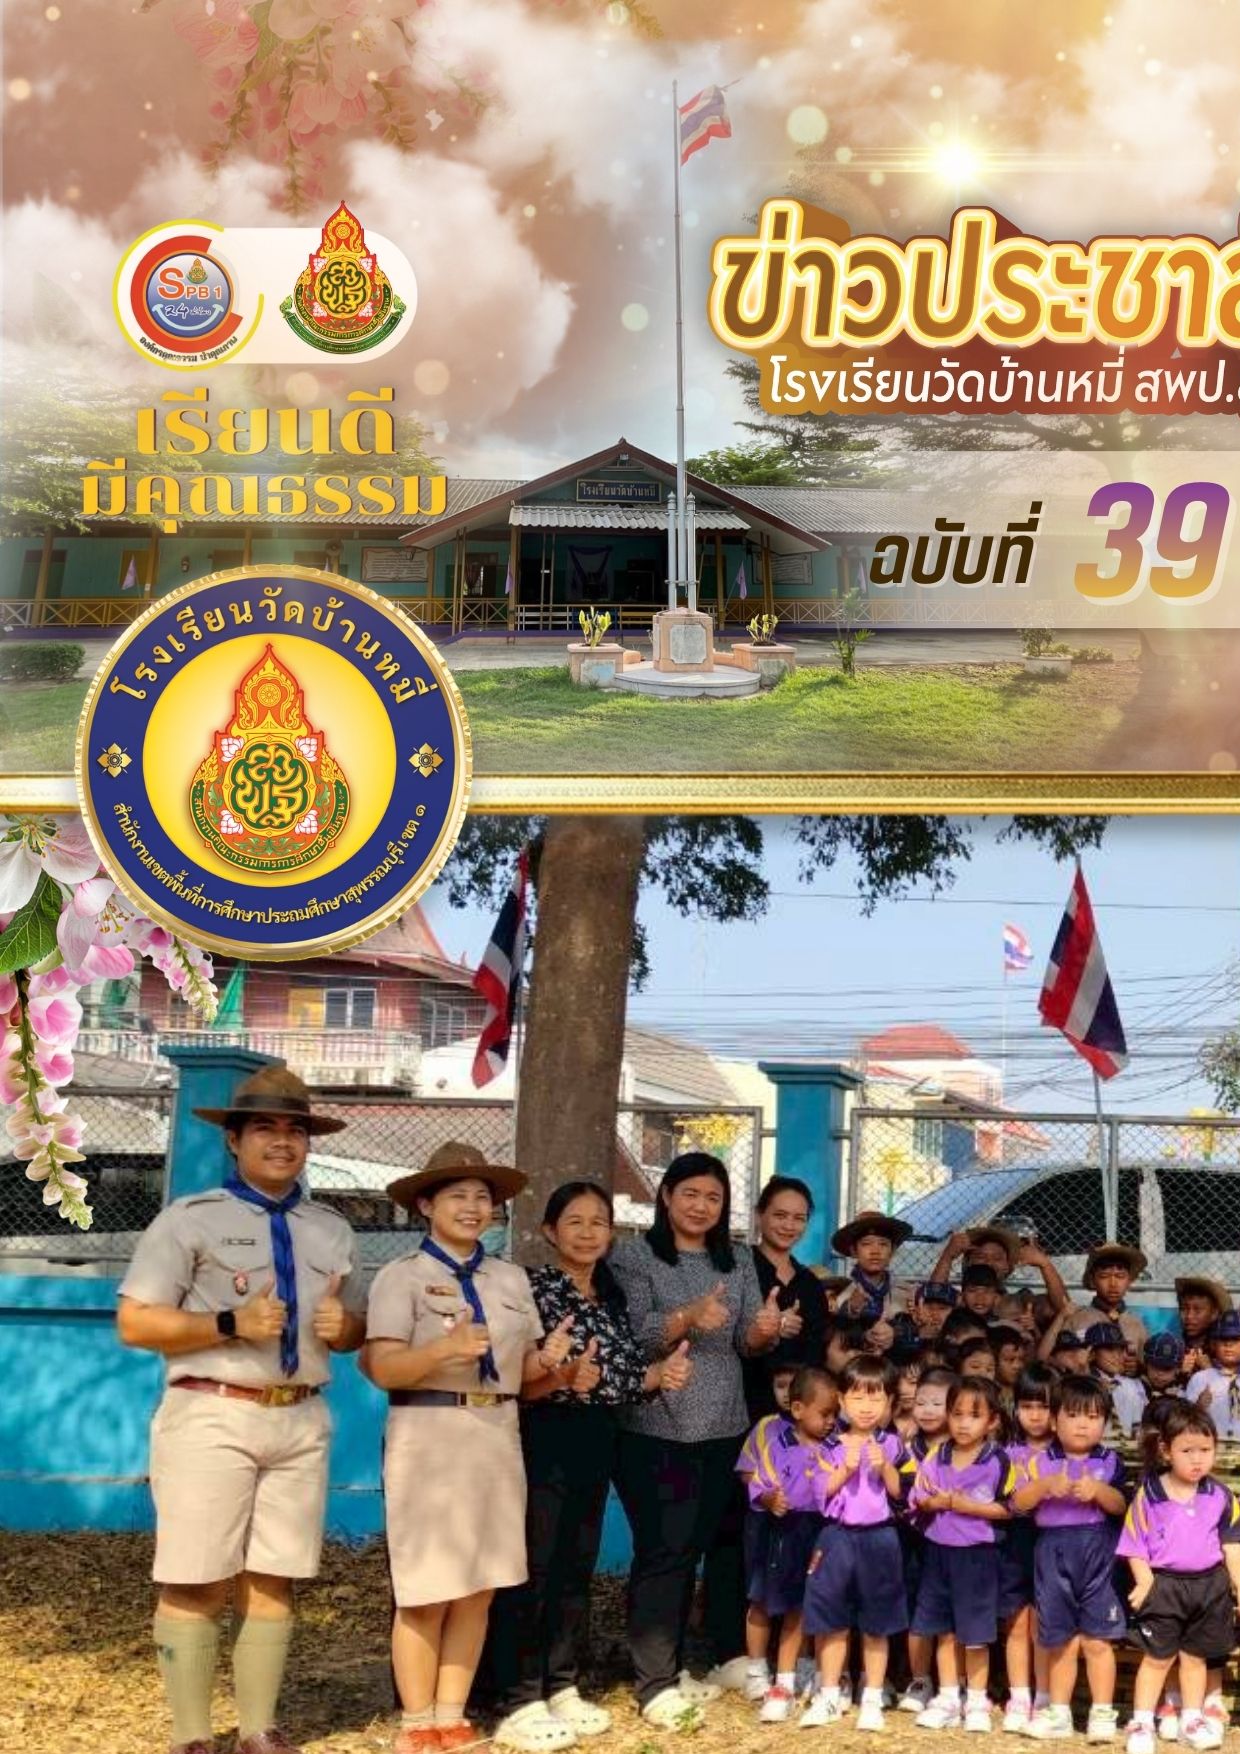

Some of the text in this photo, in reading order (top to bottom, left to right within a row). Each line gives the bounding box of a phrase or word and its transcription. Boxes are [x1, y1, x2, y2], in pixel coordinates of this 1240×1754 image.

[157, 267, 209, 299] SPB
[770, 345, 1126, 403] โรงเรียนวัดบ้านหมี่
[136, 387, 398, 456] เรียนดี
[80, 458, 449, 534] มีคุณธรรม
[870, 501, 1043, 585] ฉบับที่
[1074, 480, 1232, 600] 39
[110, 586, 438, 703] โรงเรียนวัดบ้านหมี่
